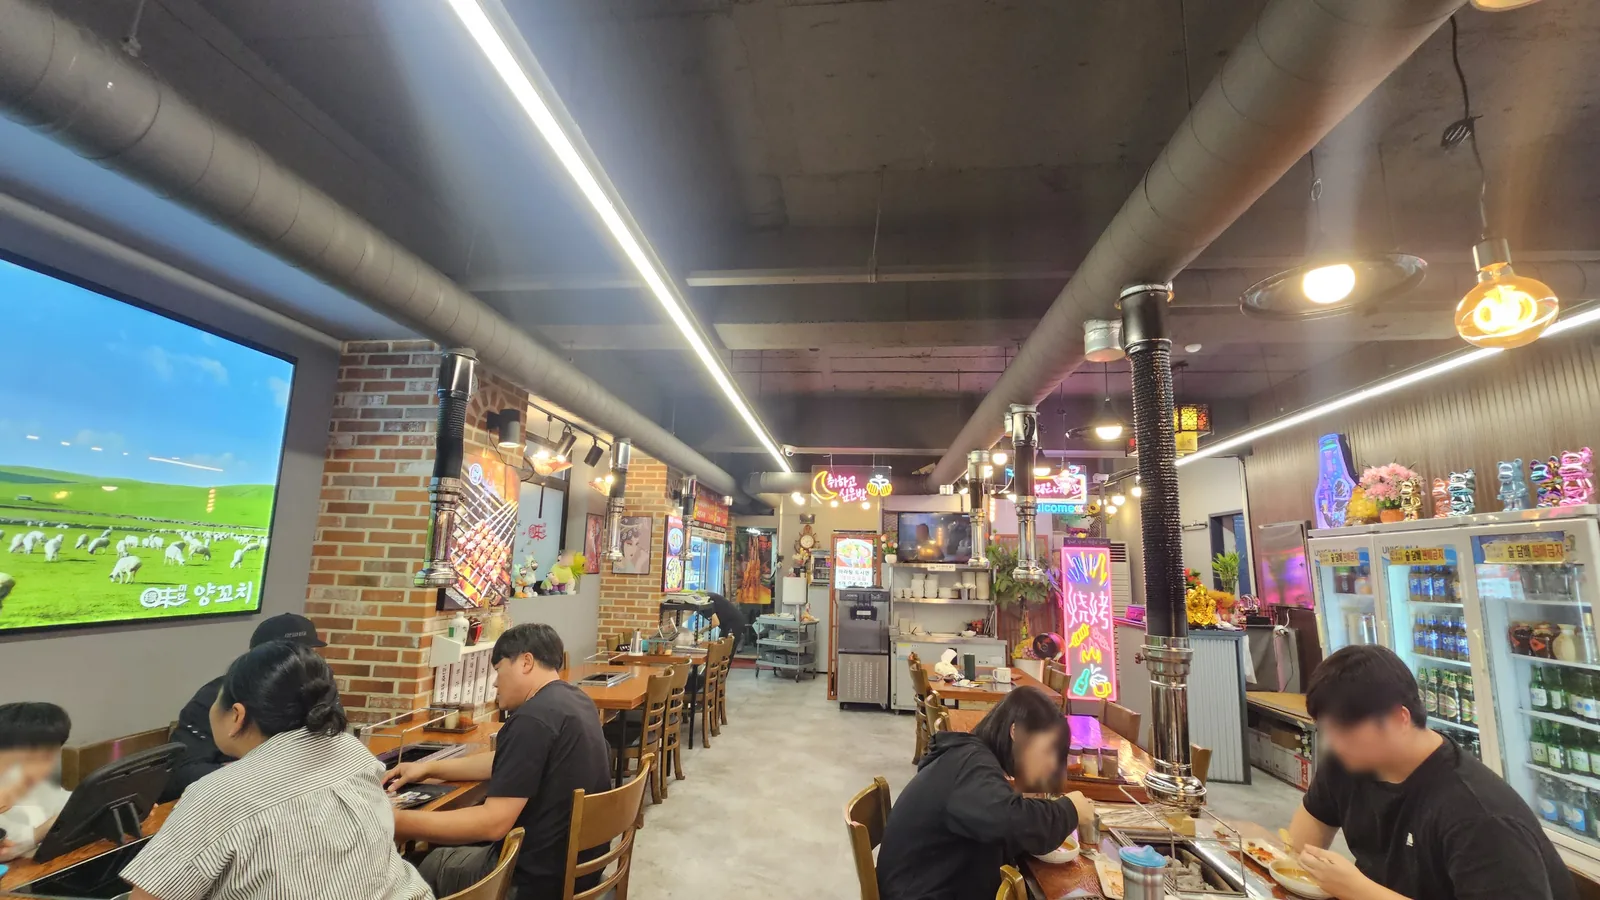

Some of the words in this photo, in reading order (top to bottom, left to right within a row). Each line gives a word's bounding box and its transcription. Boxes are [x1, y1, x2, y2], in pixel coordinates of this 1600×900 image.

[827, 473, 857, 488] 취하고
[1036, 503, 1075, 513] lcome
[194, 581, 252, 606] 양꼬치
[1067, 582, 1109, 629] 烧烤
